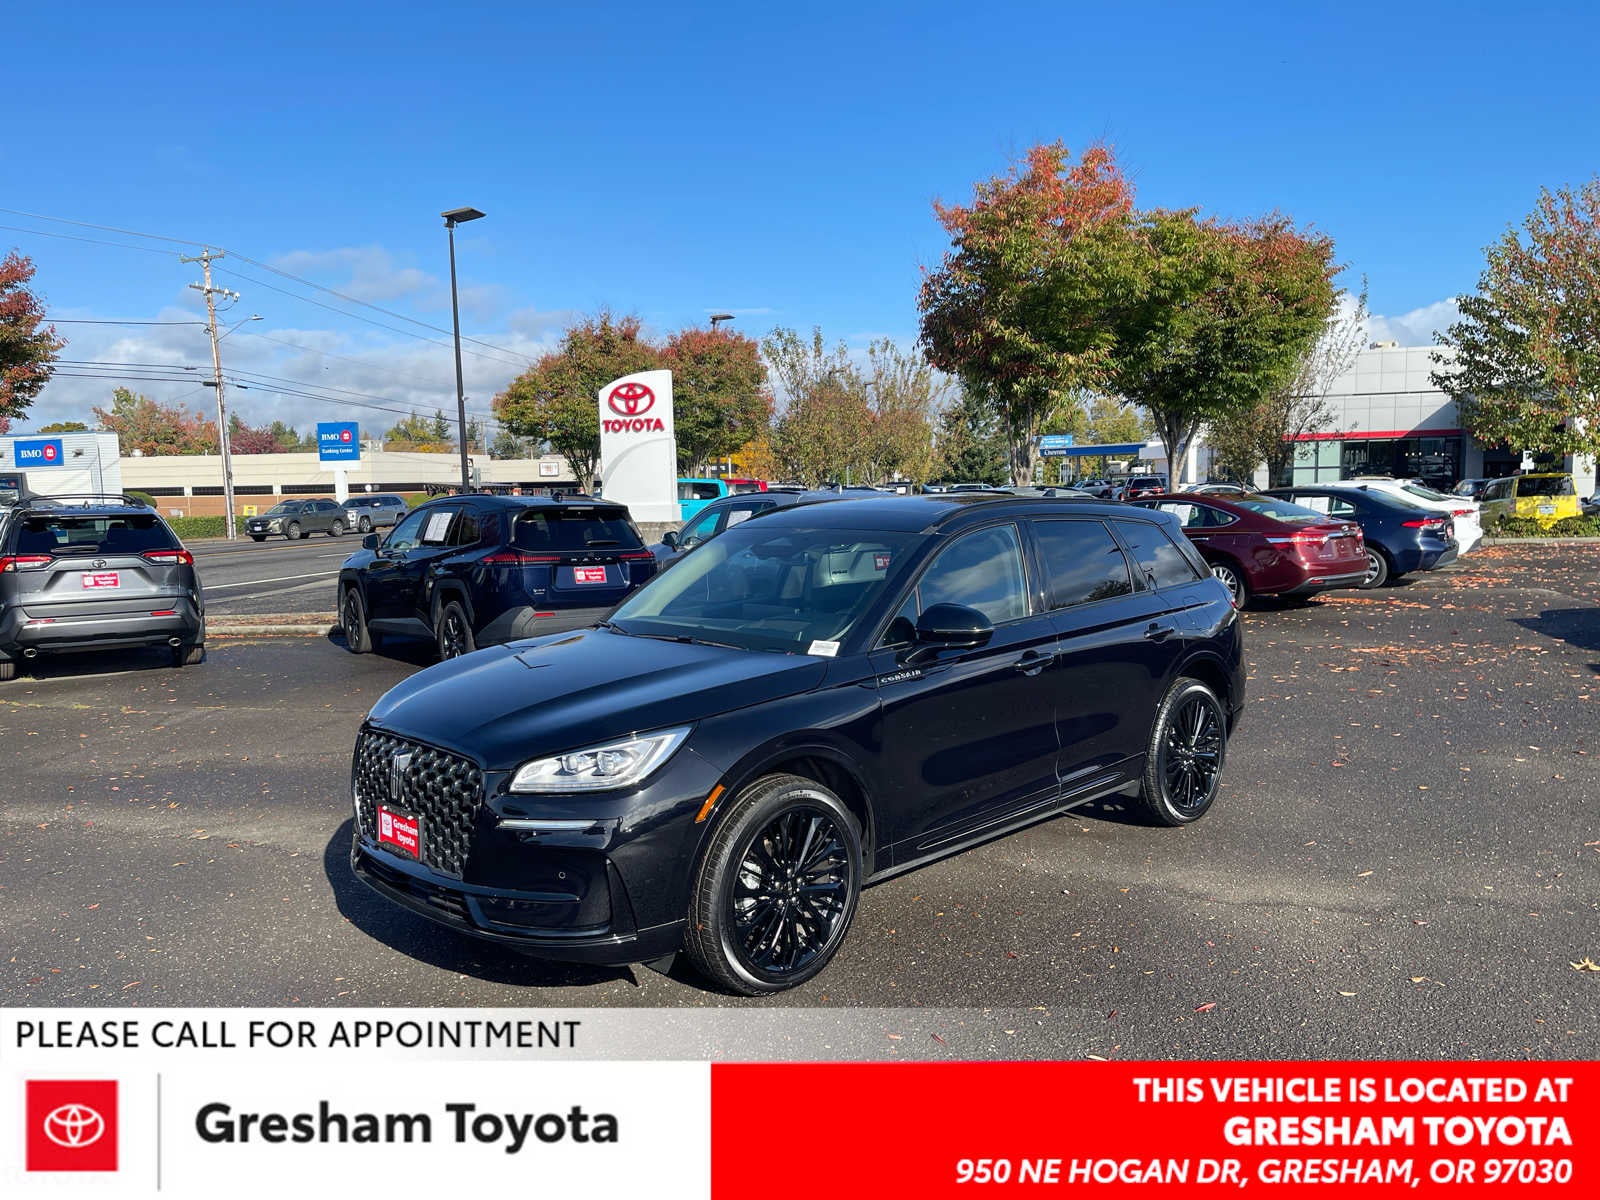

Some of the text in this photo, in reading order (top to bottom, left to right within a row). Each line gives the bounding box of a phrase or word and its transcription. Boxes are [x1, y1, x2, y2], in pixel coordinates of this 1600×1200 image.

[602, 418, 664, 433] TOYOTA
[20, 449, 42, 458] BMO
[881, 669, 921, 683] CORSAIR
[393, 818, 418, 836] Gresham
[396, 831, 415, 847] Toyota
